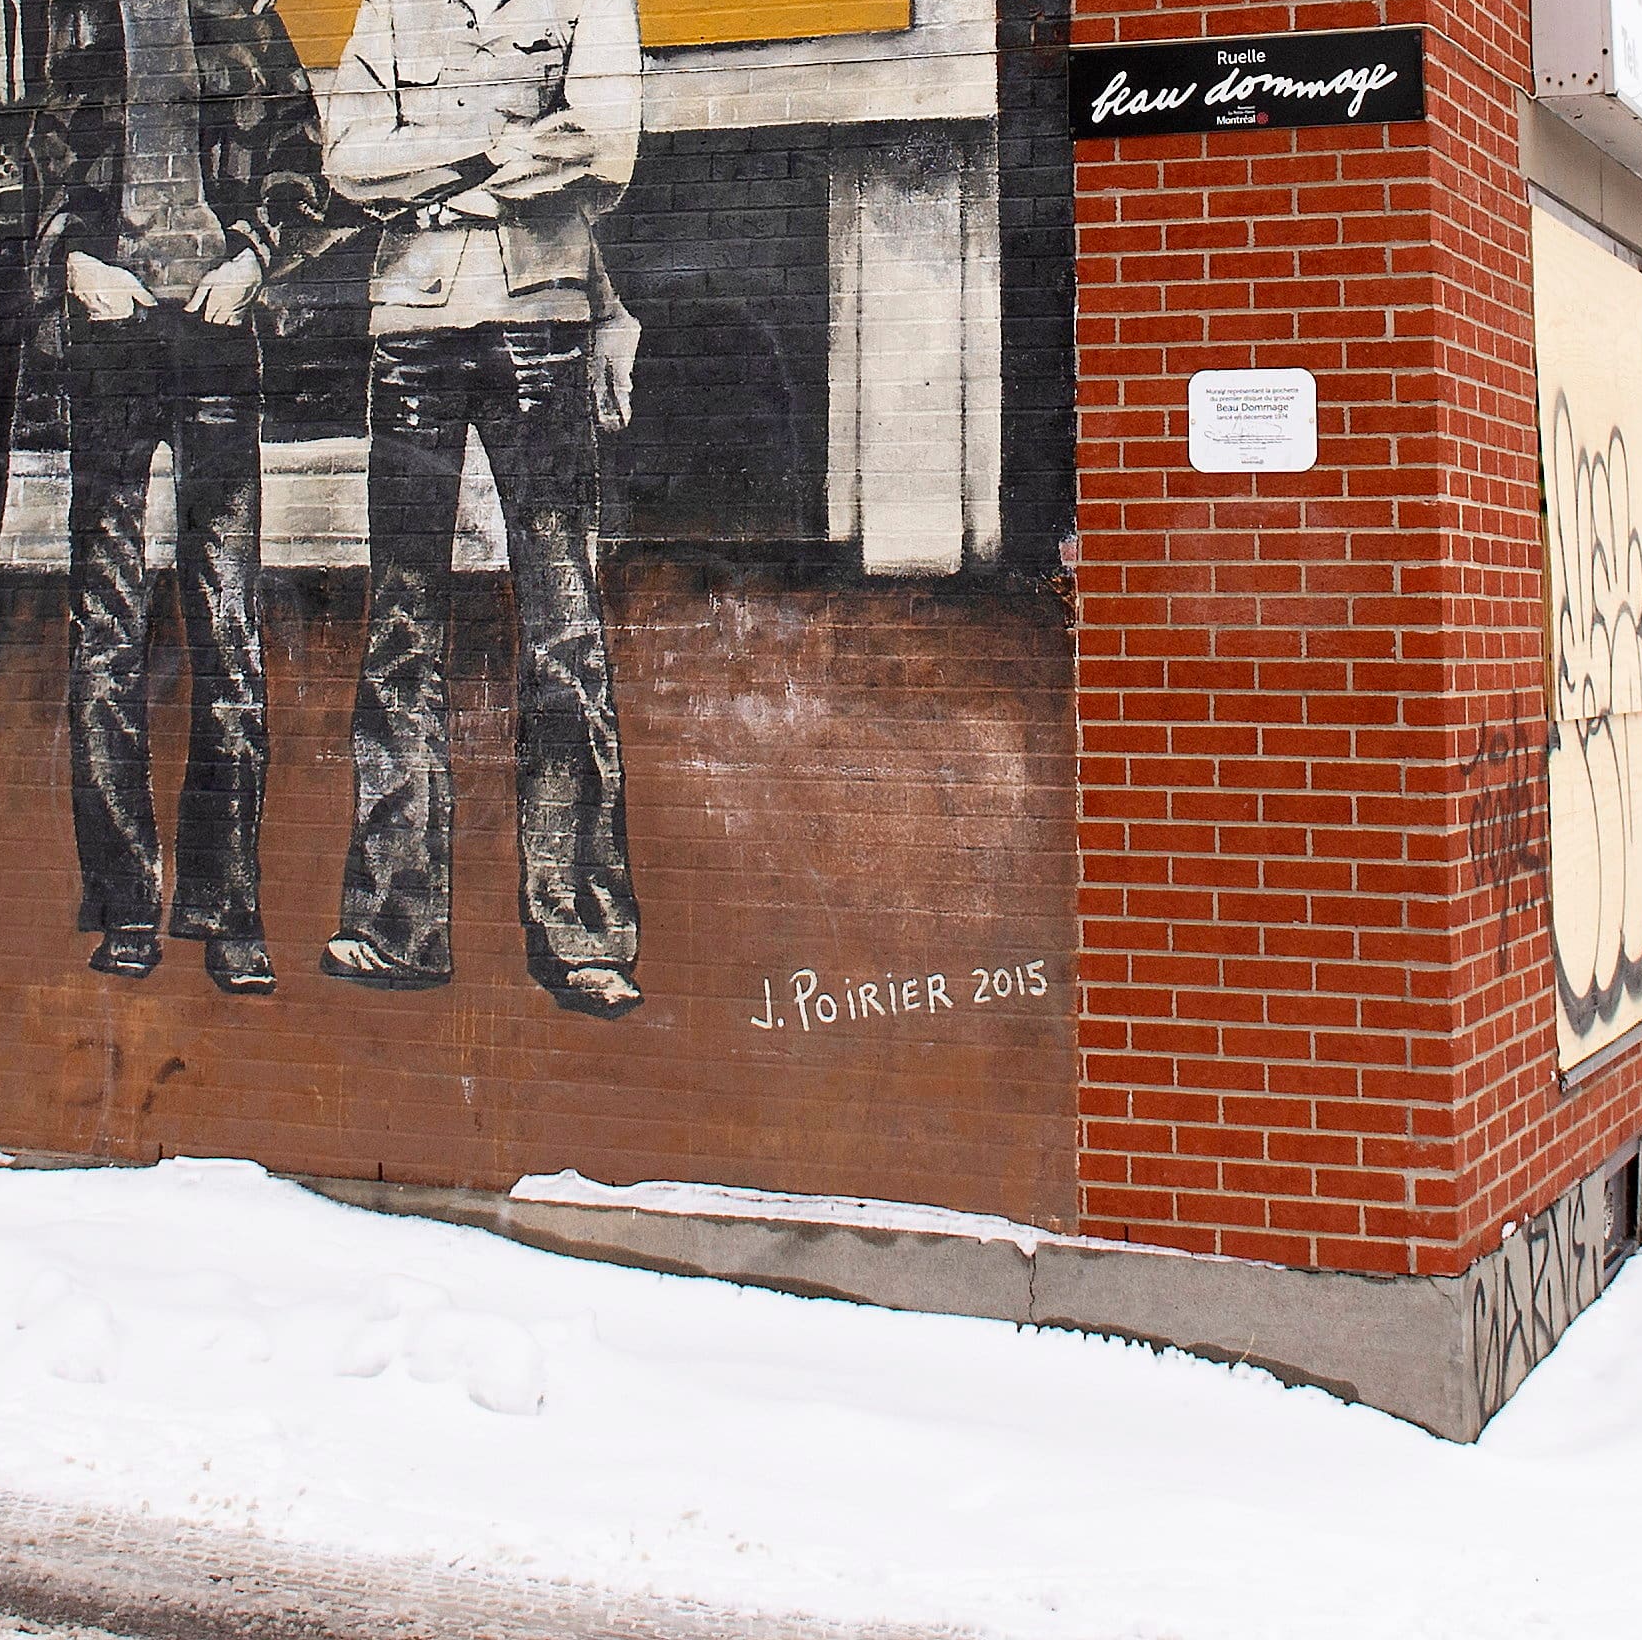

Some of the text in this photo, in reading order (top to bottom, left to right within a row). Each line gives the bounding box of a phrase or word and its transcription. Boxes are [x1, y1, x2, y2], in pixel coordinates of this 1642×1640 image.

[1217, 48, 1267, 66] Ruelle
[1092, 63, 1398, 124] beau dommage
[1216, 402, 1289, 413] Beau Dommage
[750, 977, 784, 1030] J.
[971, 960, 1048, 1004] 2015
